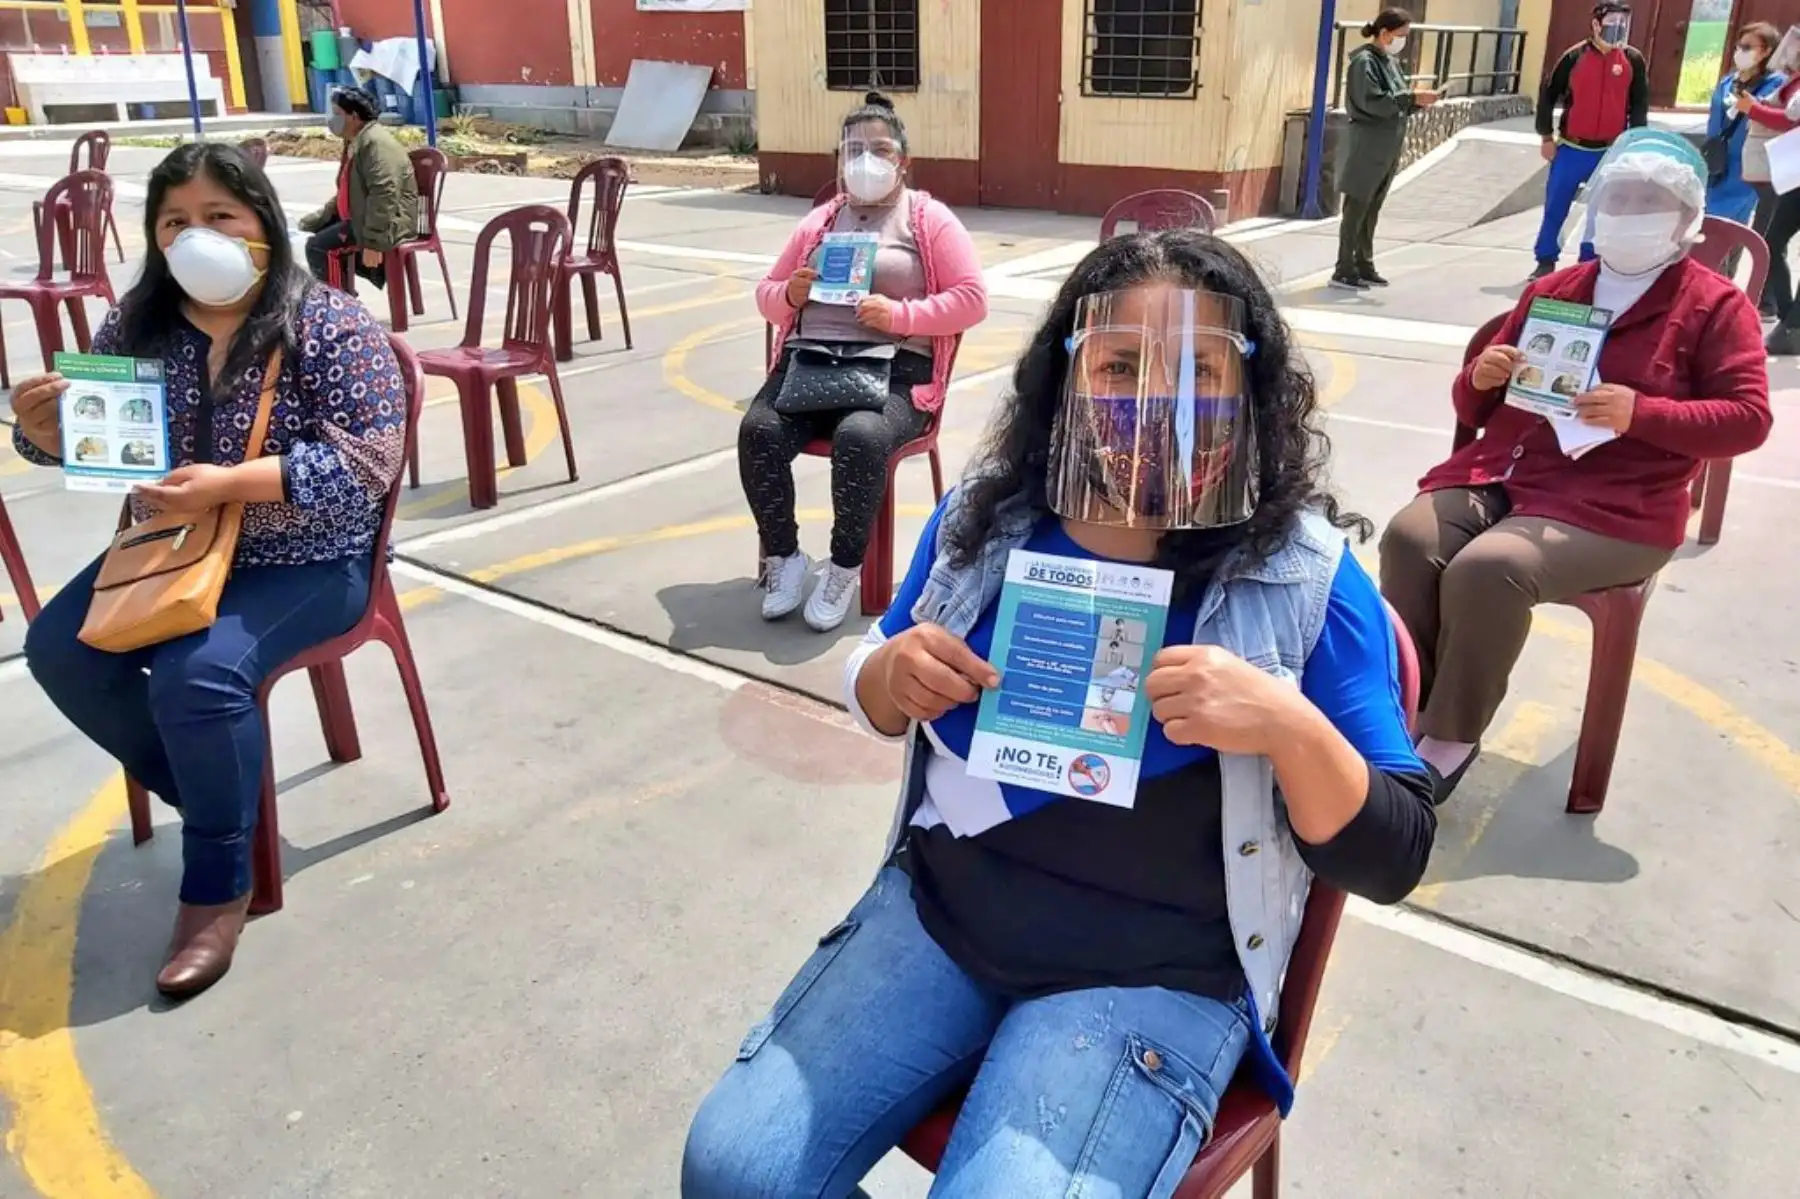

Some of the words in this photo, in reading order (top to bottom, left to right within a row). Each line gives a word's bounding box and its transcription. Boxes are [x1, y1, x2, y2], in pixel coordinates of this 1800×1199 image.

[1029, 567, 1046, 579] DE
[1049, 570, 1093, 586] TODOS
[995, 746, 1032, 764] ¡NO
